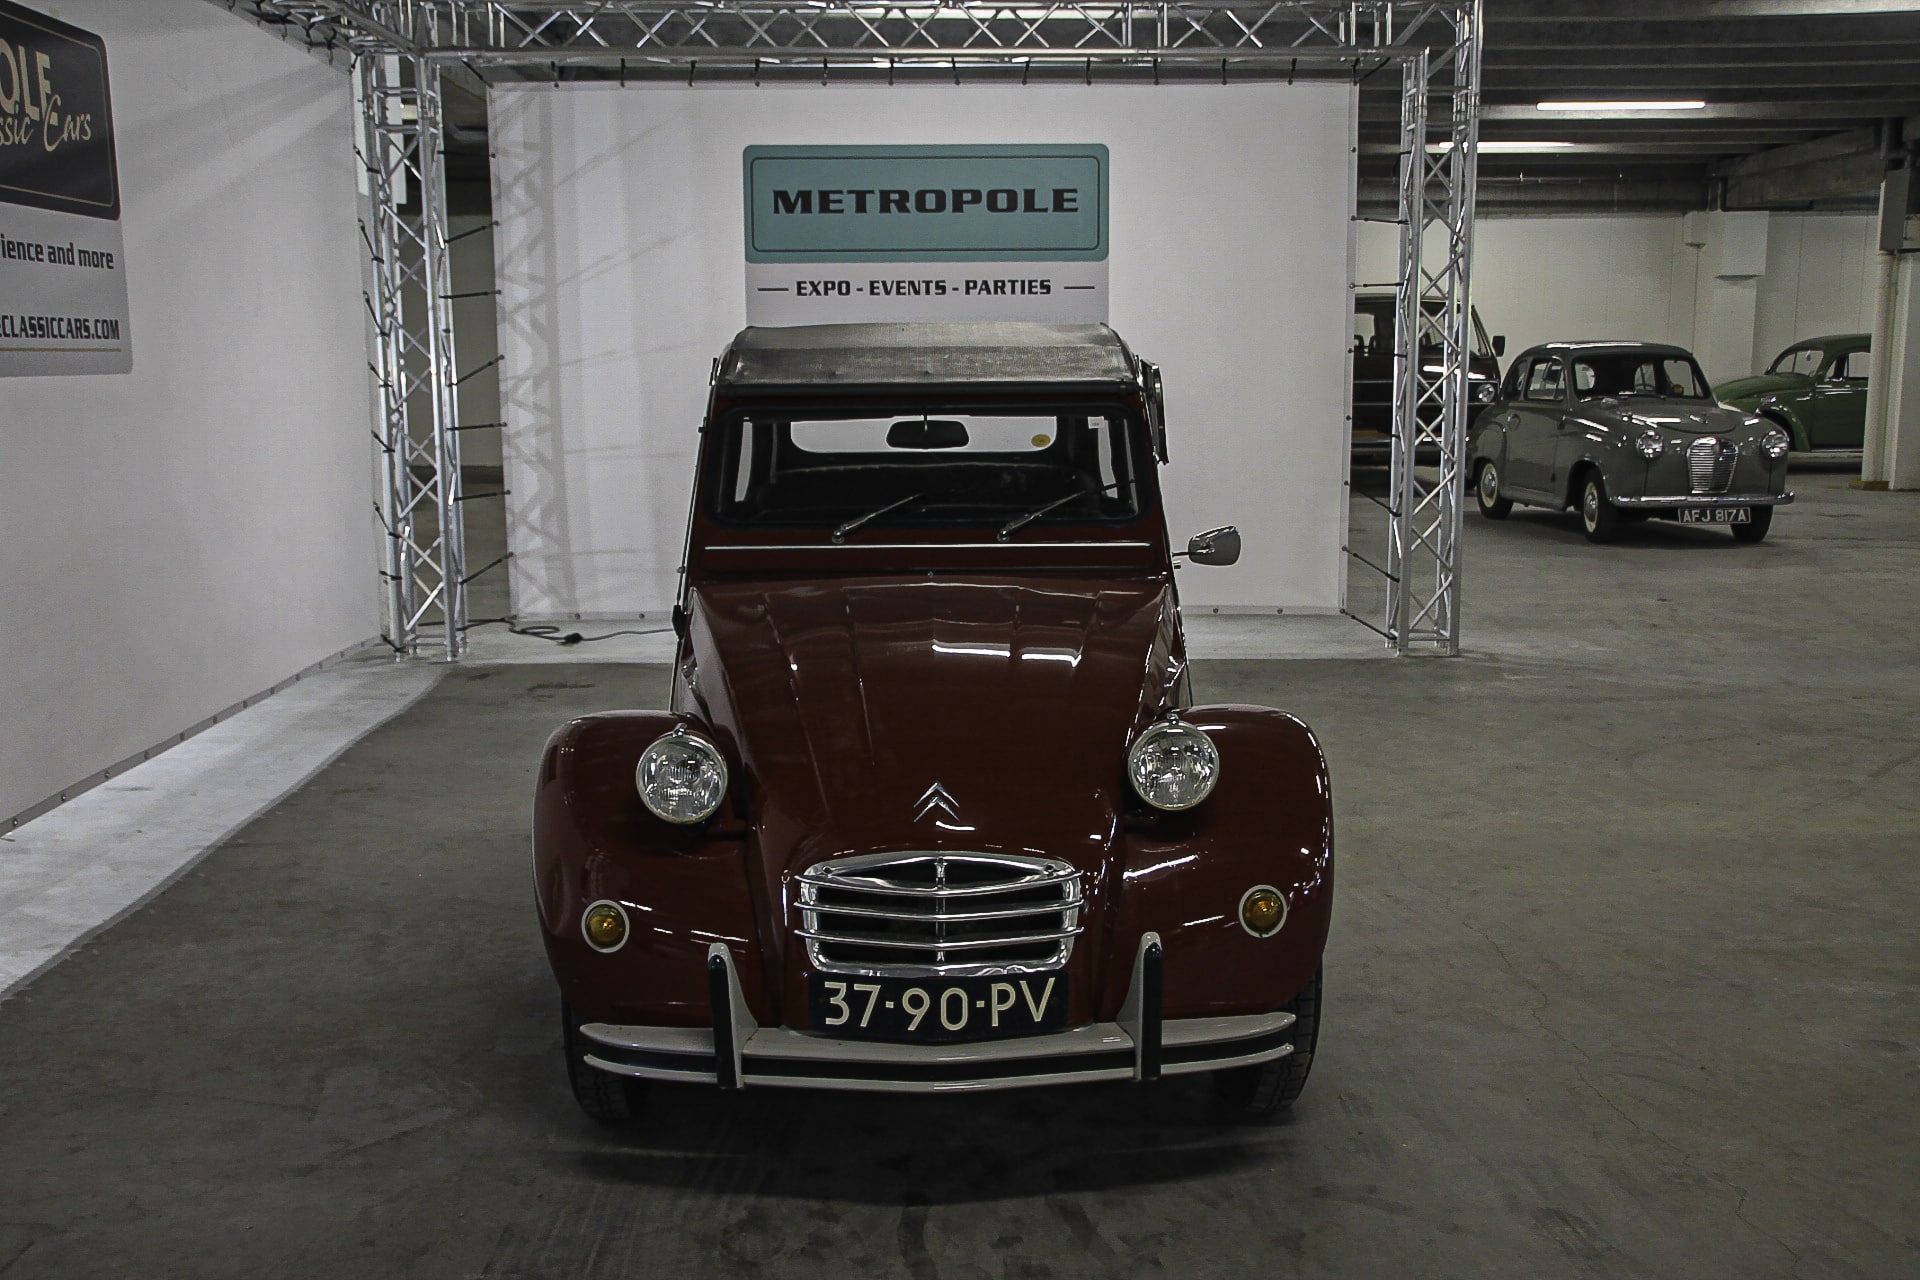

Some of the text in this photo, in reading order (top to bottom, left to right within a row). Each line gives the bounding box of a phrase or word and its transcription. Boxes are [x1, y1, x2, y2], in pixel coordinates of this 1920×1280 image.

[44, 94, 92, 152] Cars
[773, 188, 1079, 214] METROPOLE
[47, 242, 76, 266] and
[78, 248, 115, 270] more
[796, 280, 851, 297] EXPO
[869, 280, 947, 296] EVENTS
[964, 279, 1052, 295] PARTIES
[0, 315, 120, 340] CLASSICCARS.COM
[1683, 509, 1747, 523] AFJ 817A
[824, 977, 1056, 1031] 37-90-PV
